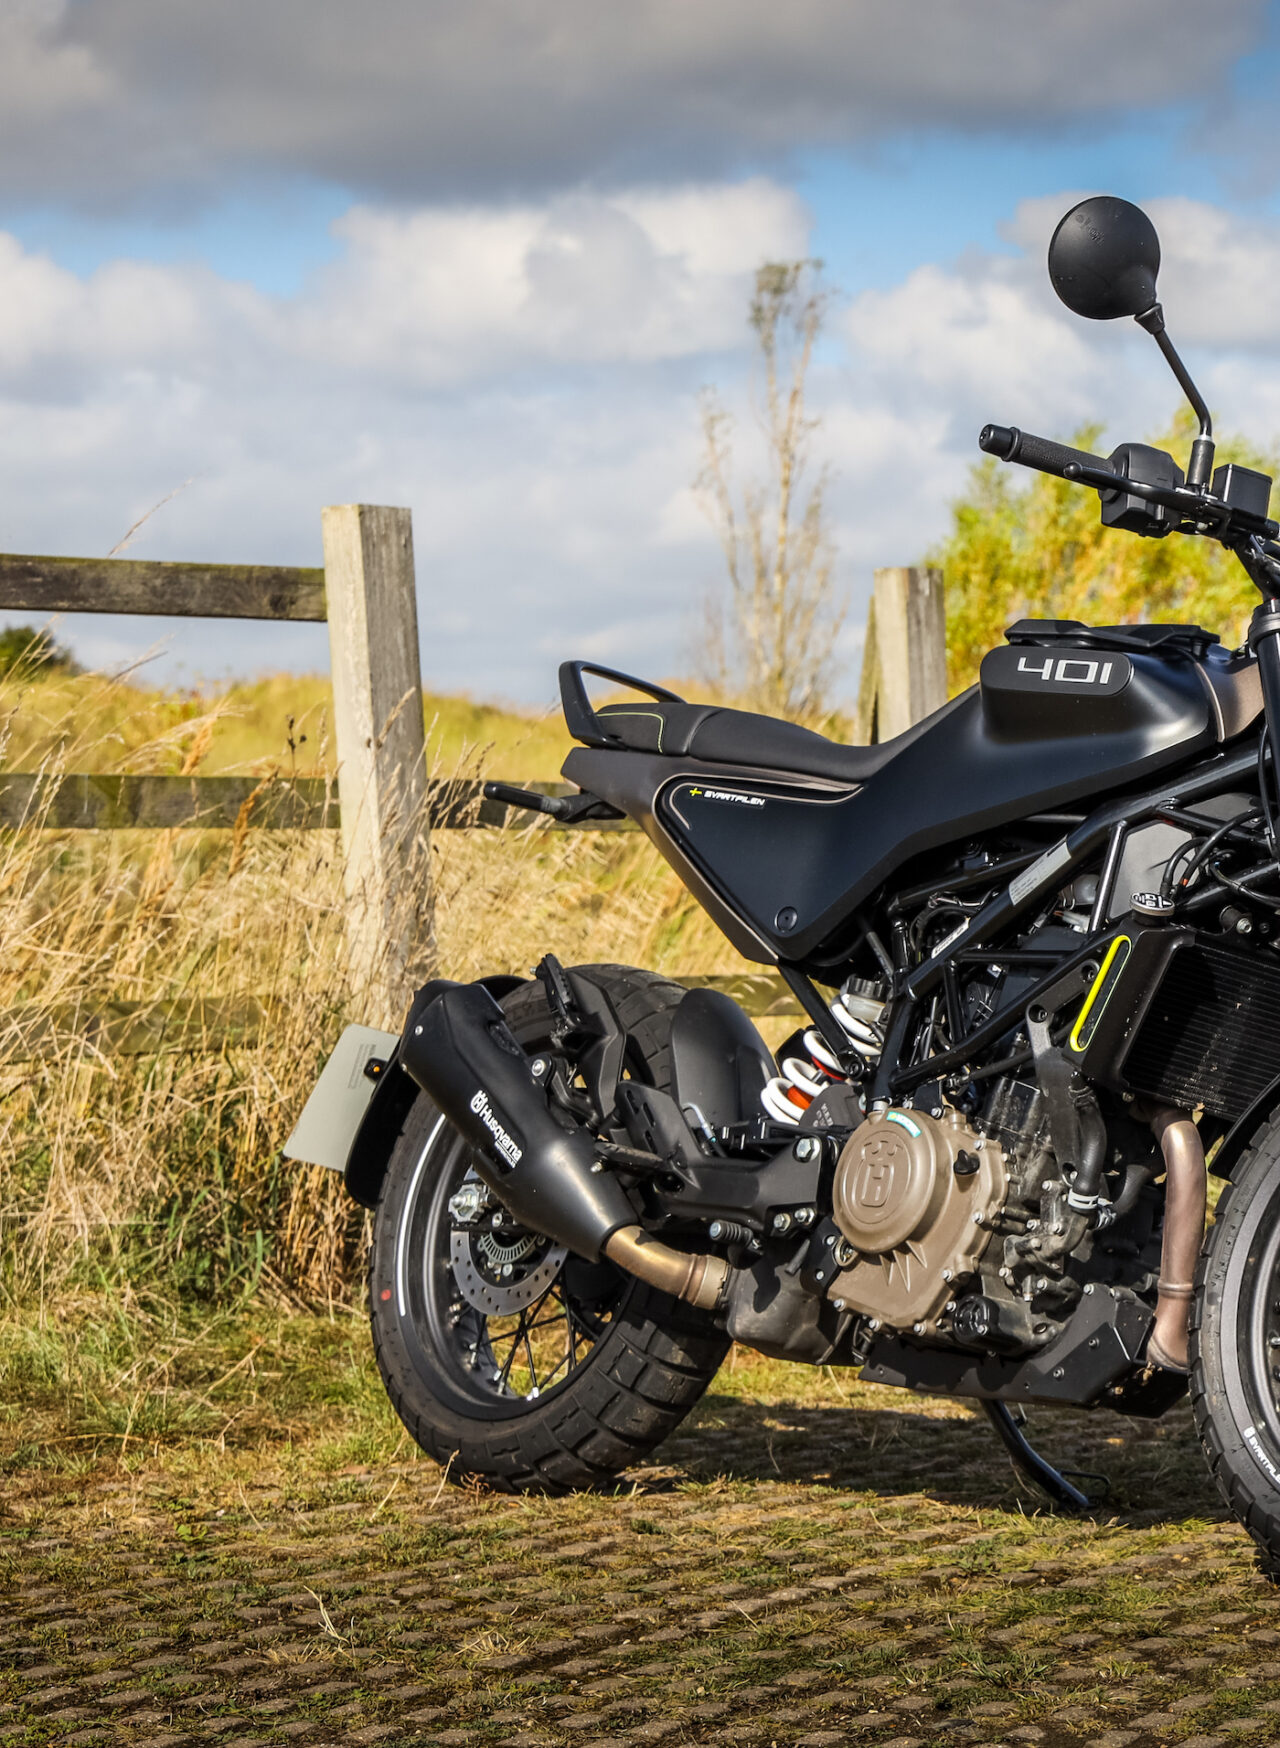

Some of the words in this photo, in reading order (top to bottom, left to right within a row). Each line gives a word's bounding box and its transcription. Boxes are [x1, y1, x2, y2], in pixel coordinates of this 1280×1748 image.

[1017, 656, 1113, 685] 401
[704, 790, 765, 806] SVARTPILEN
[479, 1104, 523, 1163] Husqvarna
